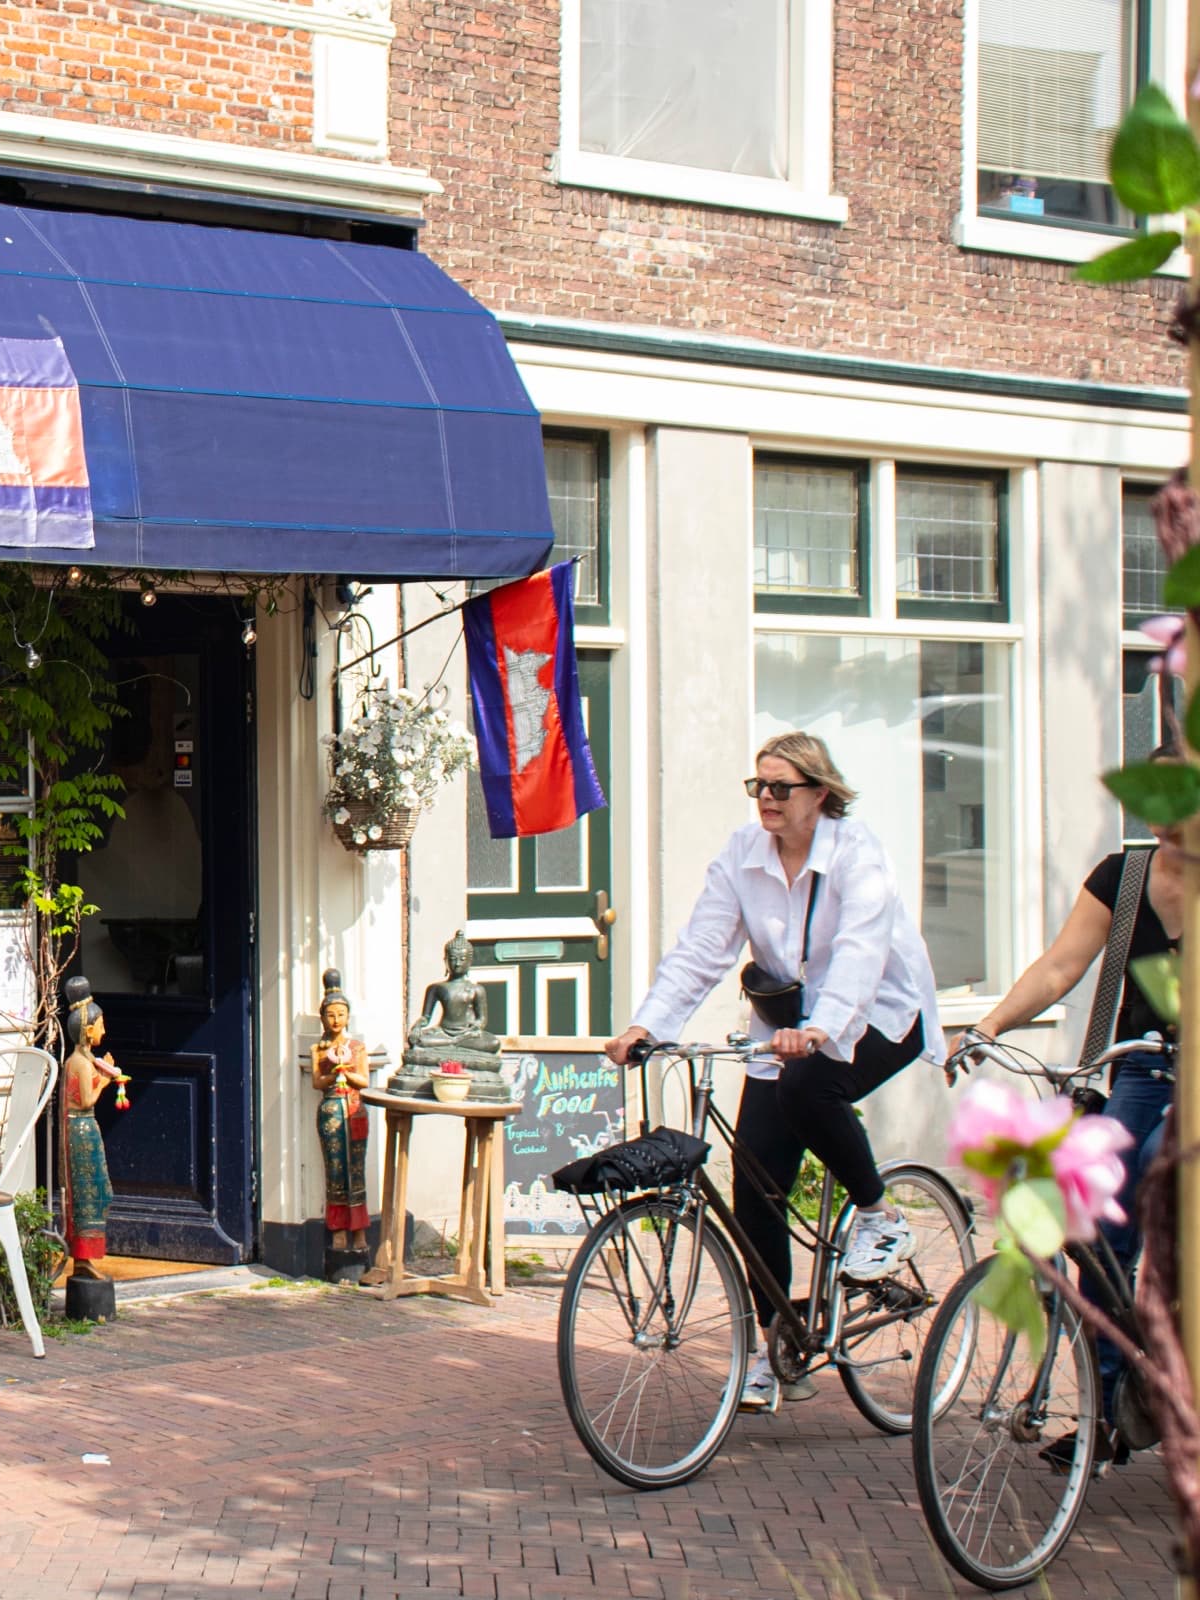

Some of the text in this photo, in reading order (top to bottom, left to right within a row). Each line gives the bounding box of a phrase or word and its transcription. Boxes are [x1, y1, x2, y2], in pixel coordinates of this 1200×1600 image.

[534, 1061, 618, 1095] Authentic
[537, 1092, 596, 1117] Food
[504, 1122, 541, 1142] Tropical
